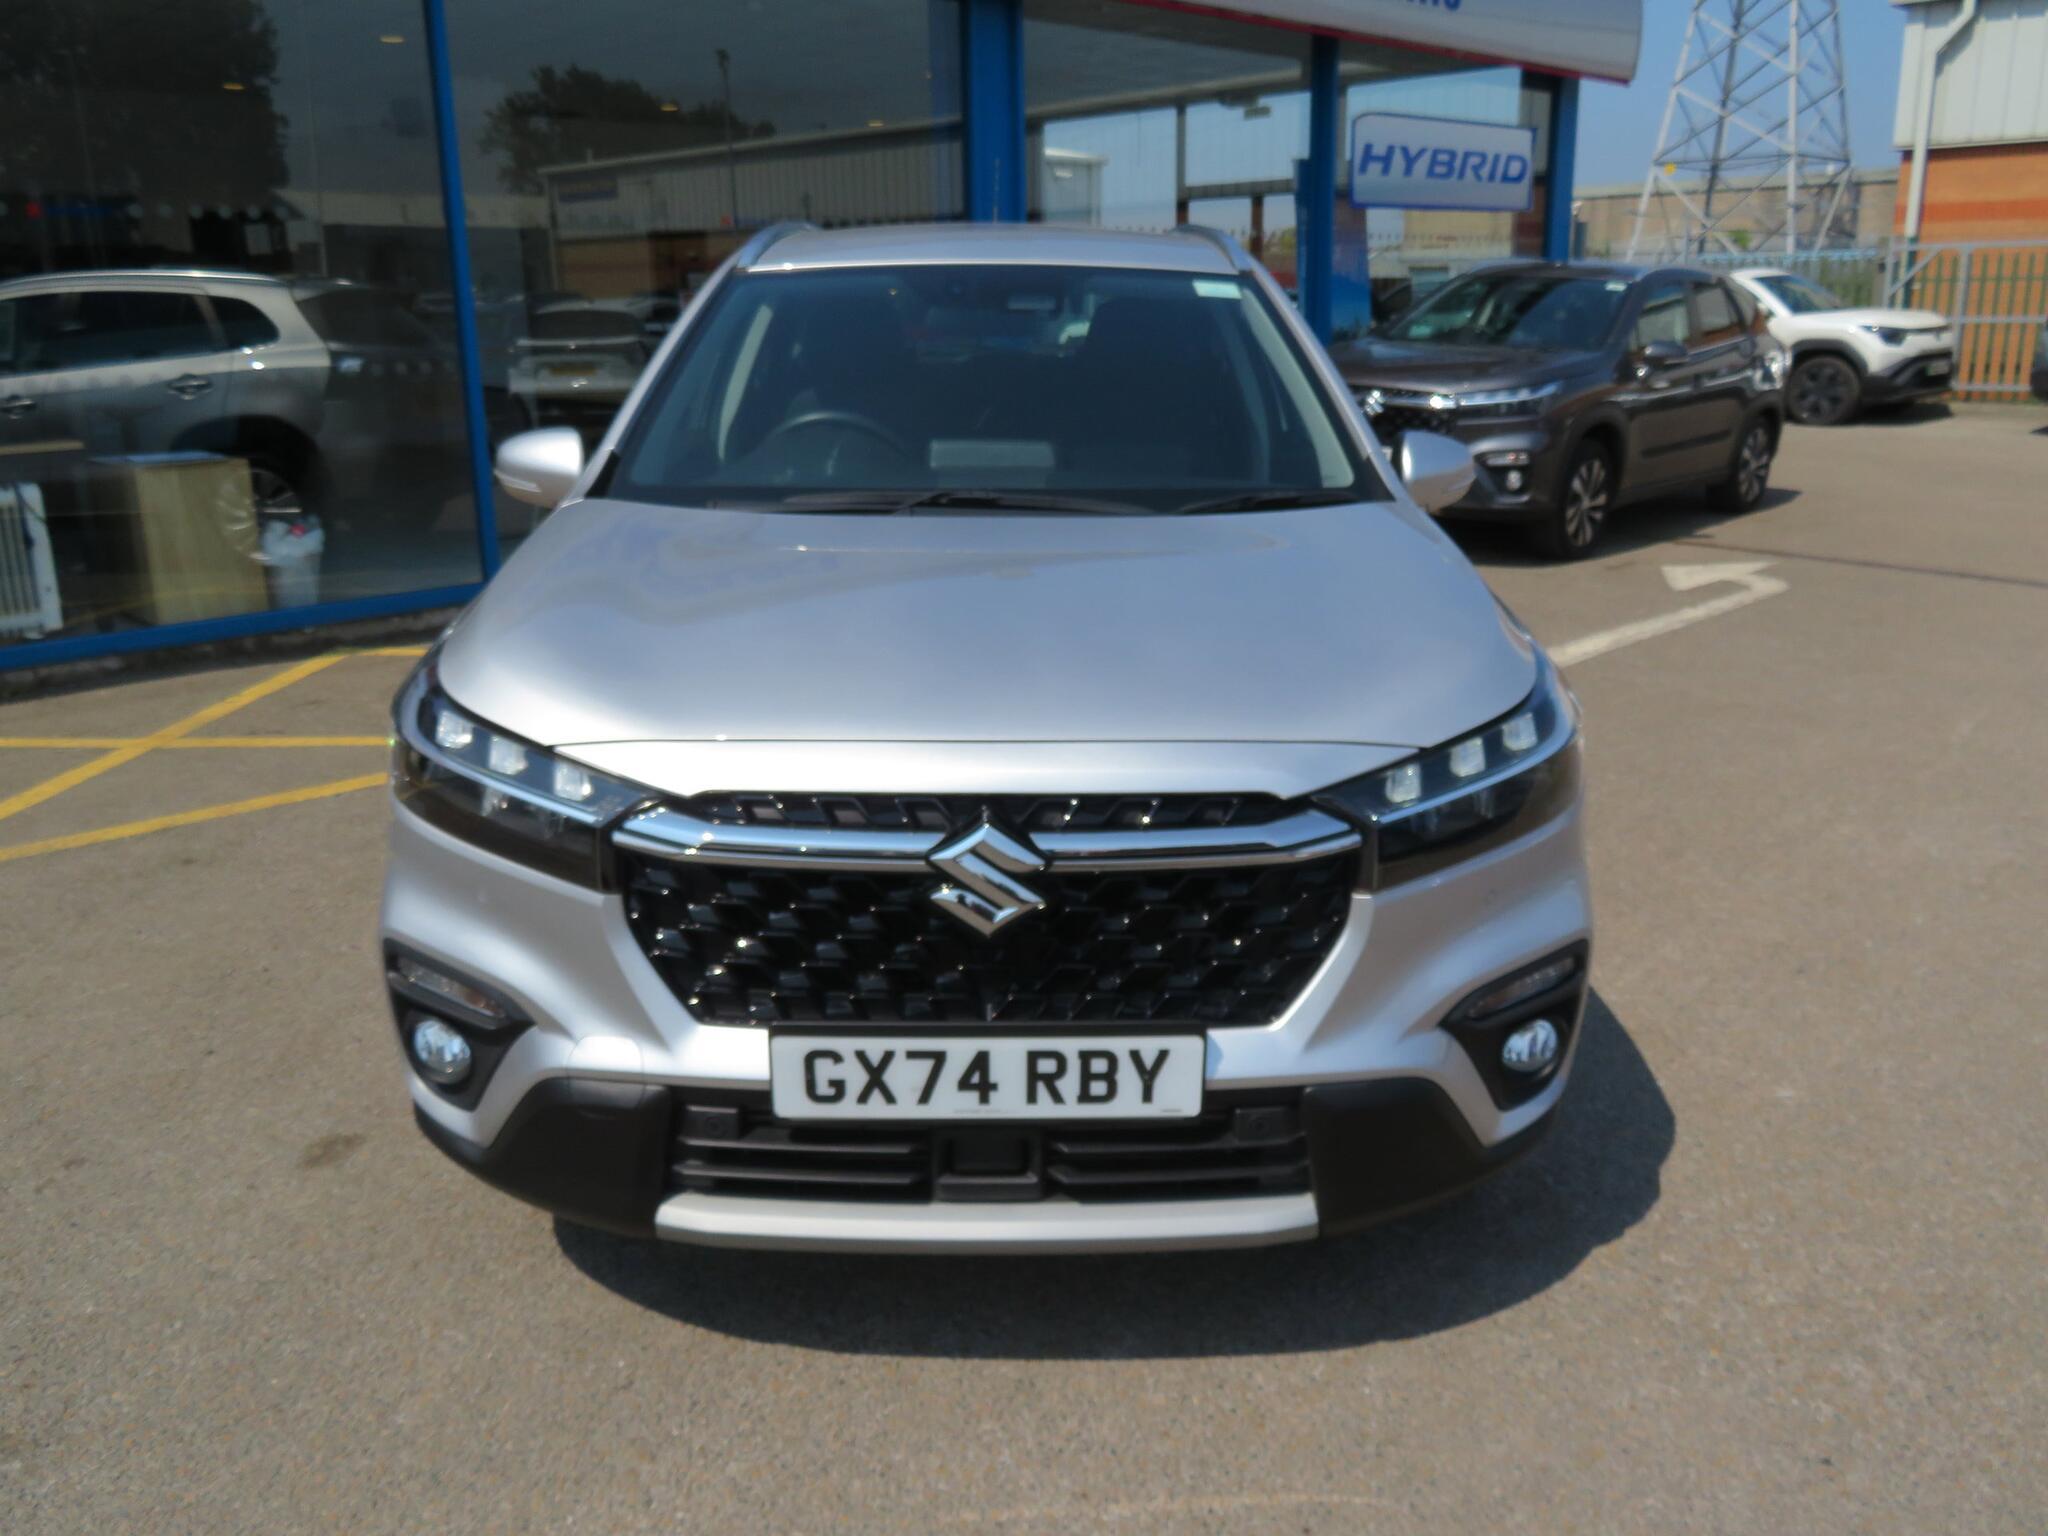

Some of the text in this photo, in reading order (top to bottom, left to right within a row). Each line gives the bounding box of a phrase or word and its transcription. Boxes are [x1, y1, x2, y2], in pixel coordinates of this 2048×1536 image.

[1358, 142, 1529, 184] HYBRID
[804, 1049, 1170, 1105] GX74 RBY
